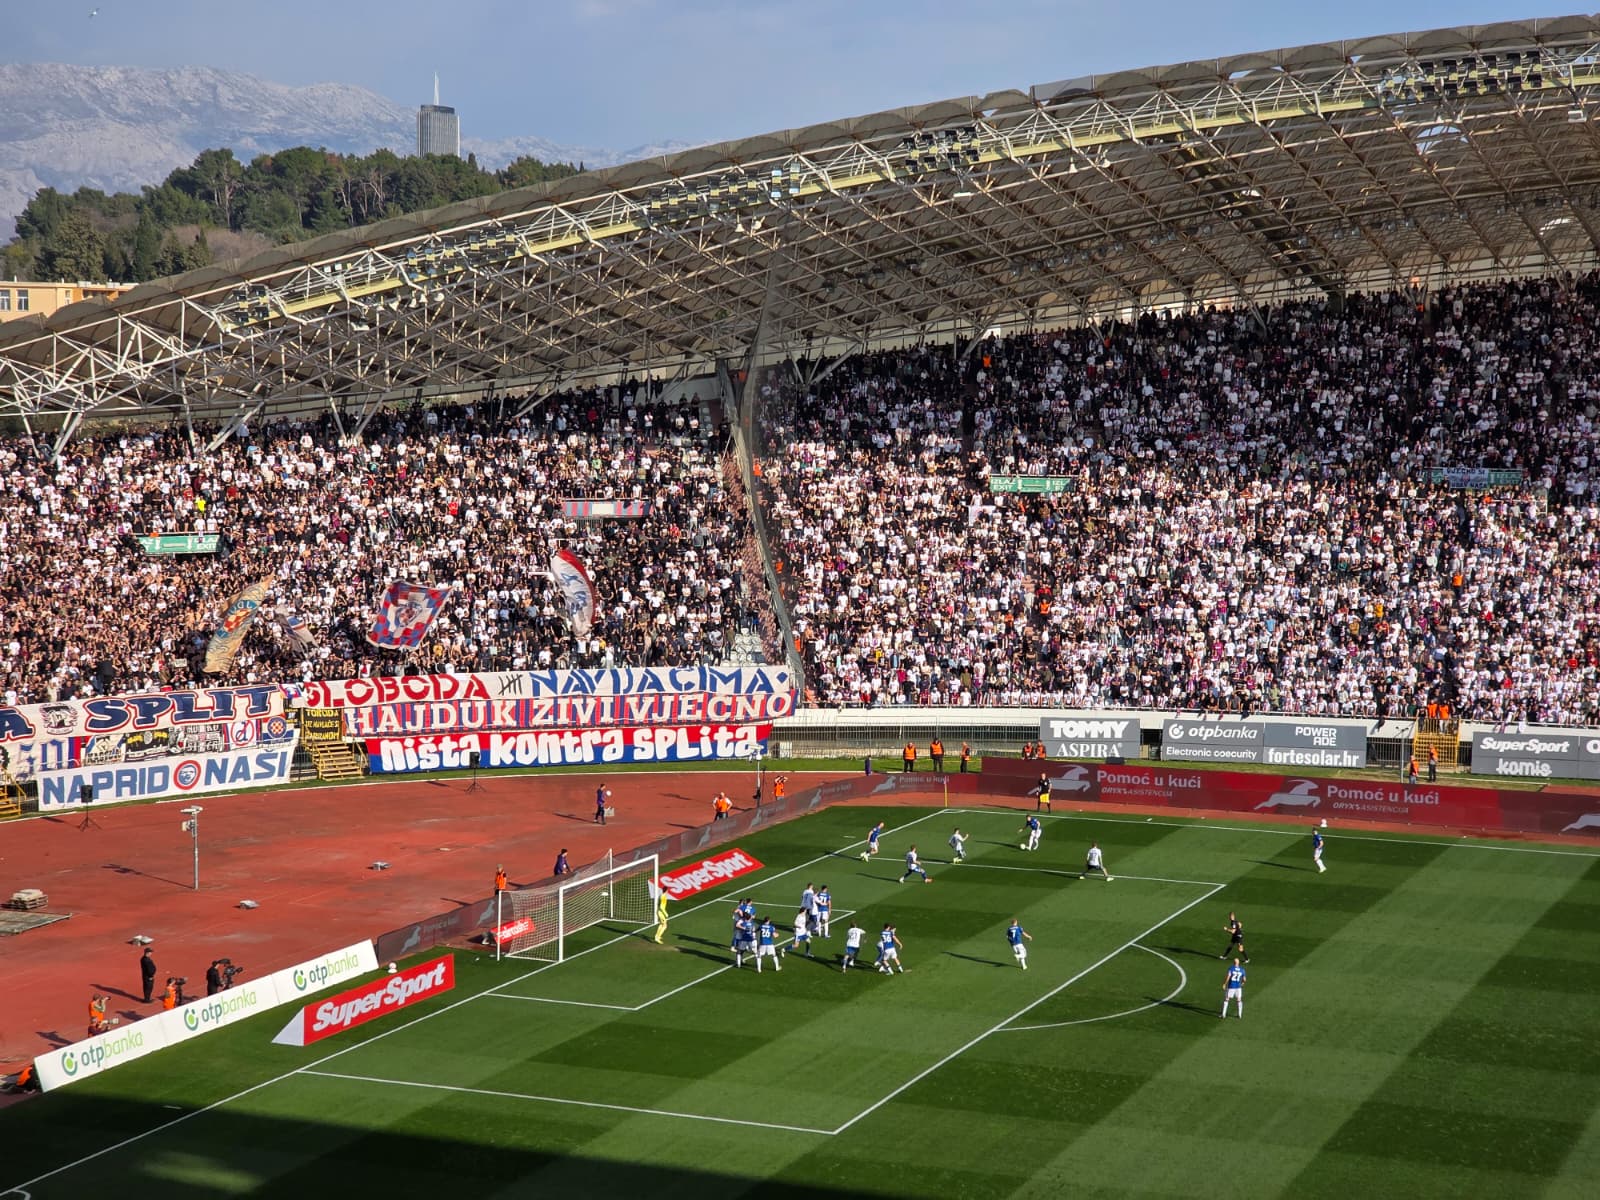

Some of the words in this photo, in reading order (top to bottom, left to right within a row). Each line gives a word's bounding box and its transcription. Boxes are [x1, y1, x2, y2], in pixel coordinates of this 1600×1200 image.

[303, 673, 491, 707] SLOBODA
[82, 684, 281, 733] SPLIT
[344, 700, 517, 734] HAJDUK
[1050, 720, 1130, 739] TOMMY
[1188, 725, 1258, 740] otpbanka
[1295, 726, 1337, 737] POWER
[1313, 737, 1337, 746] ADE
[490, 729, 624, 766] kontra
[1166, 746, 1212, 757] Electronic
[1268, 749, 1360, 767] fortesolar.hr
[1480, 737, 1570, 754] SuperSport
[42, 764, 171, 805] NAPRID
[203, 749, 288, 786] NAŠI
[1097, 769, 1150, 785] Pomoć
[1154, 777, 1164, 786] u
[1168, 774, 1201, 789] kući
[1327, 785, 1384, 801] Pomoć
[1389, 792, 1399, 802] u
[1404, 790, 1439, 805] kući
[660, 852, 753, 894] SuperSport
[309, 951, 359, 985] otpbanka
[1231, 971, 1242, 982] 27
[201, 988, 257, 1024] otpbanka
[312, 961, 446, 1032] SuperSport
[81, 1030, 144, 1067] otpbanka
